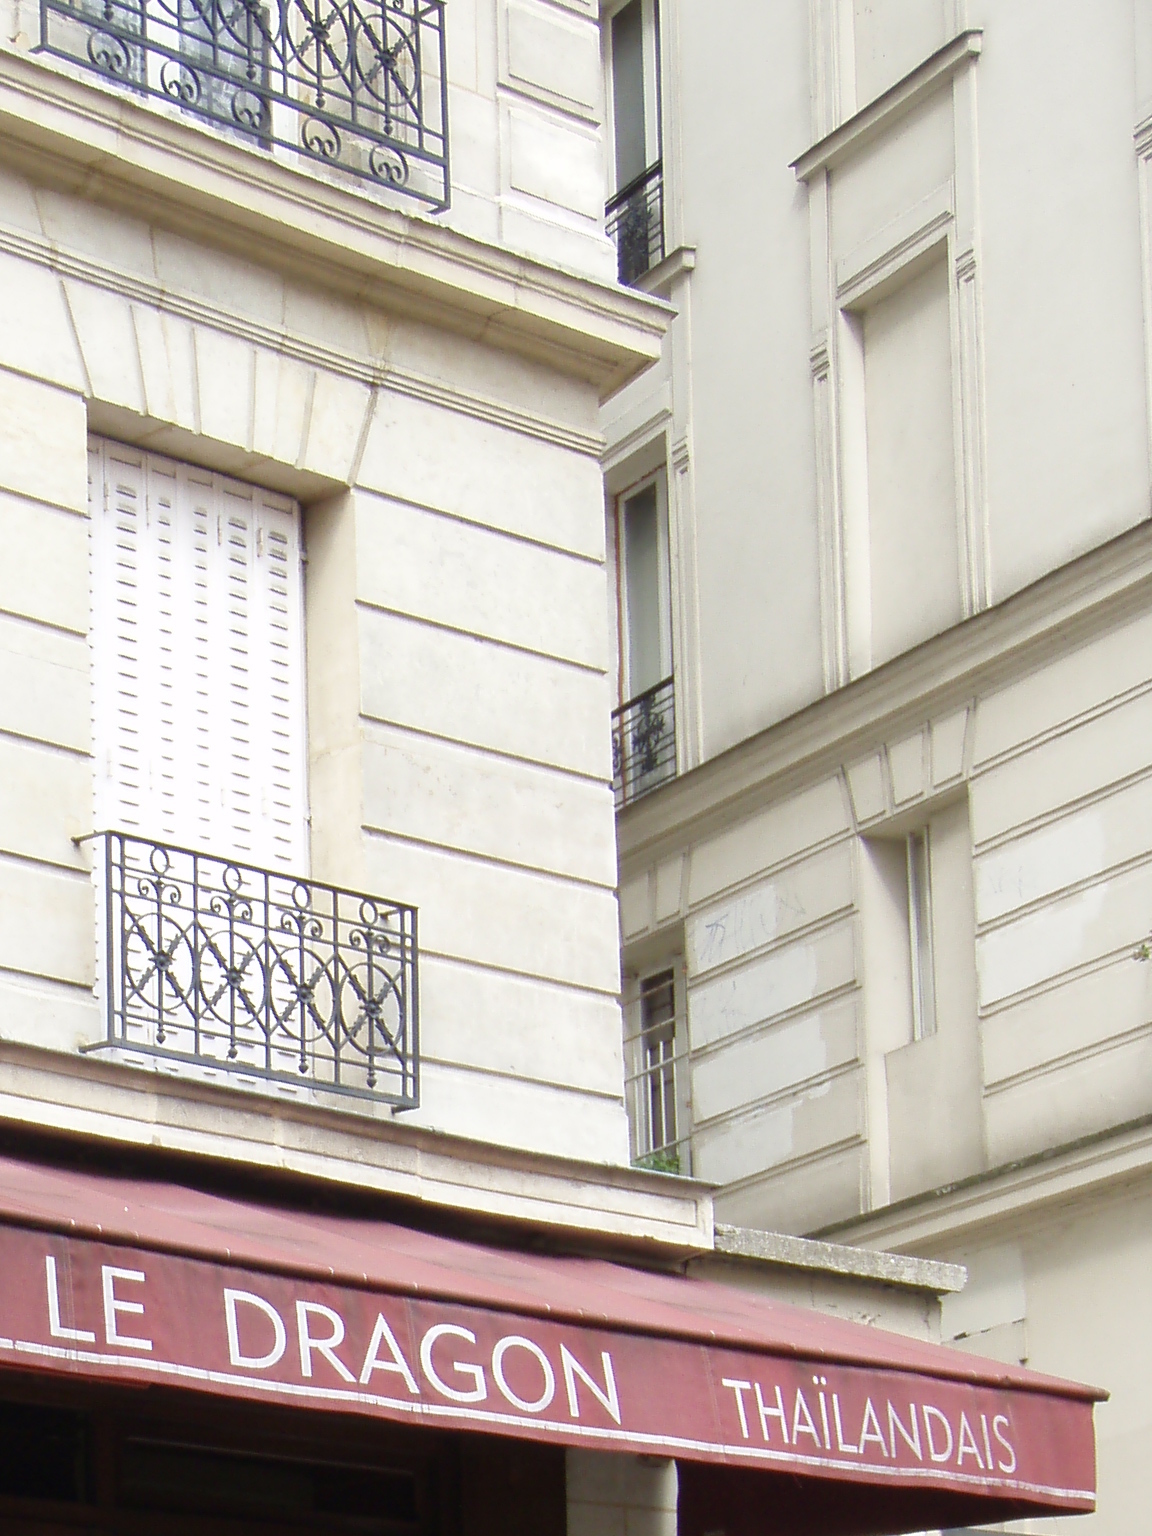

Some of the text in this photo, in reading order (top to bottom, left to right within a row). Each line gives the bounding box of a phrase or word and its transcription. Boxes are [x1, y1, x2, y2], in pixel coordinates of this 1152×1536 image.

[46, 1255, 622, 1425] LE DRAGON
[722, 1375, 1017, 1474] THAÏLANDAIS
